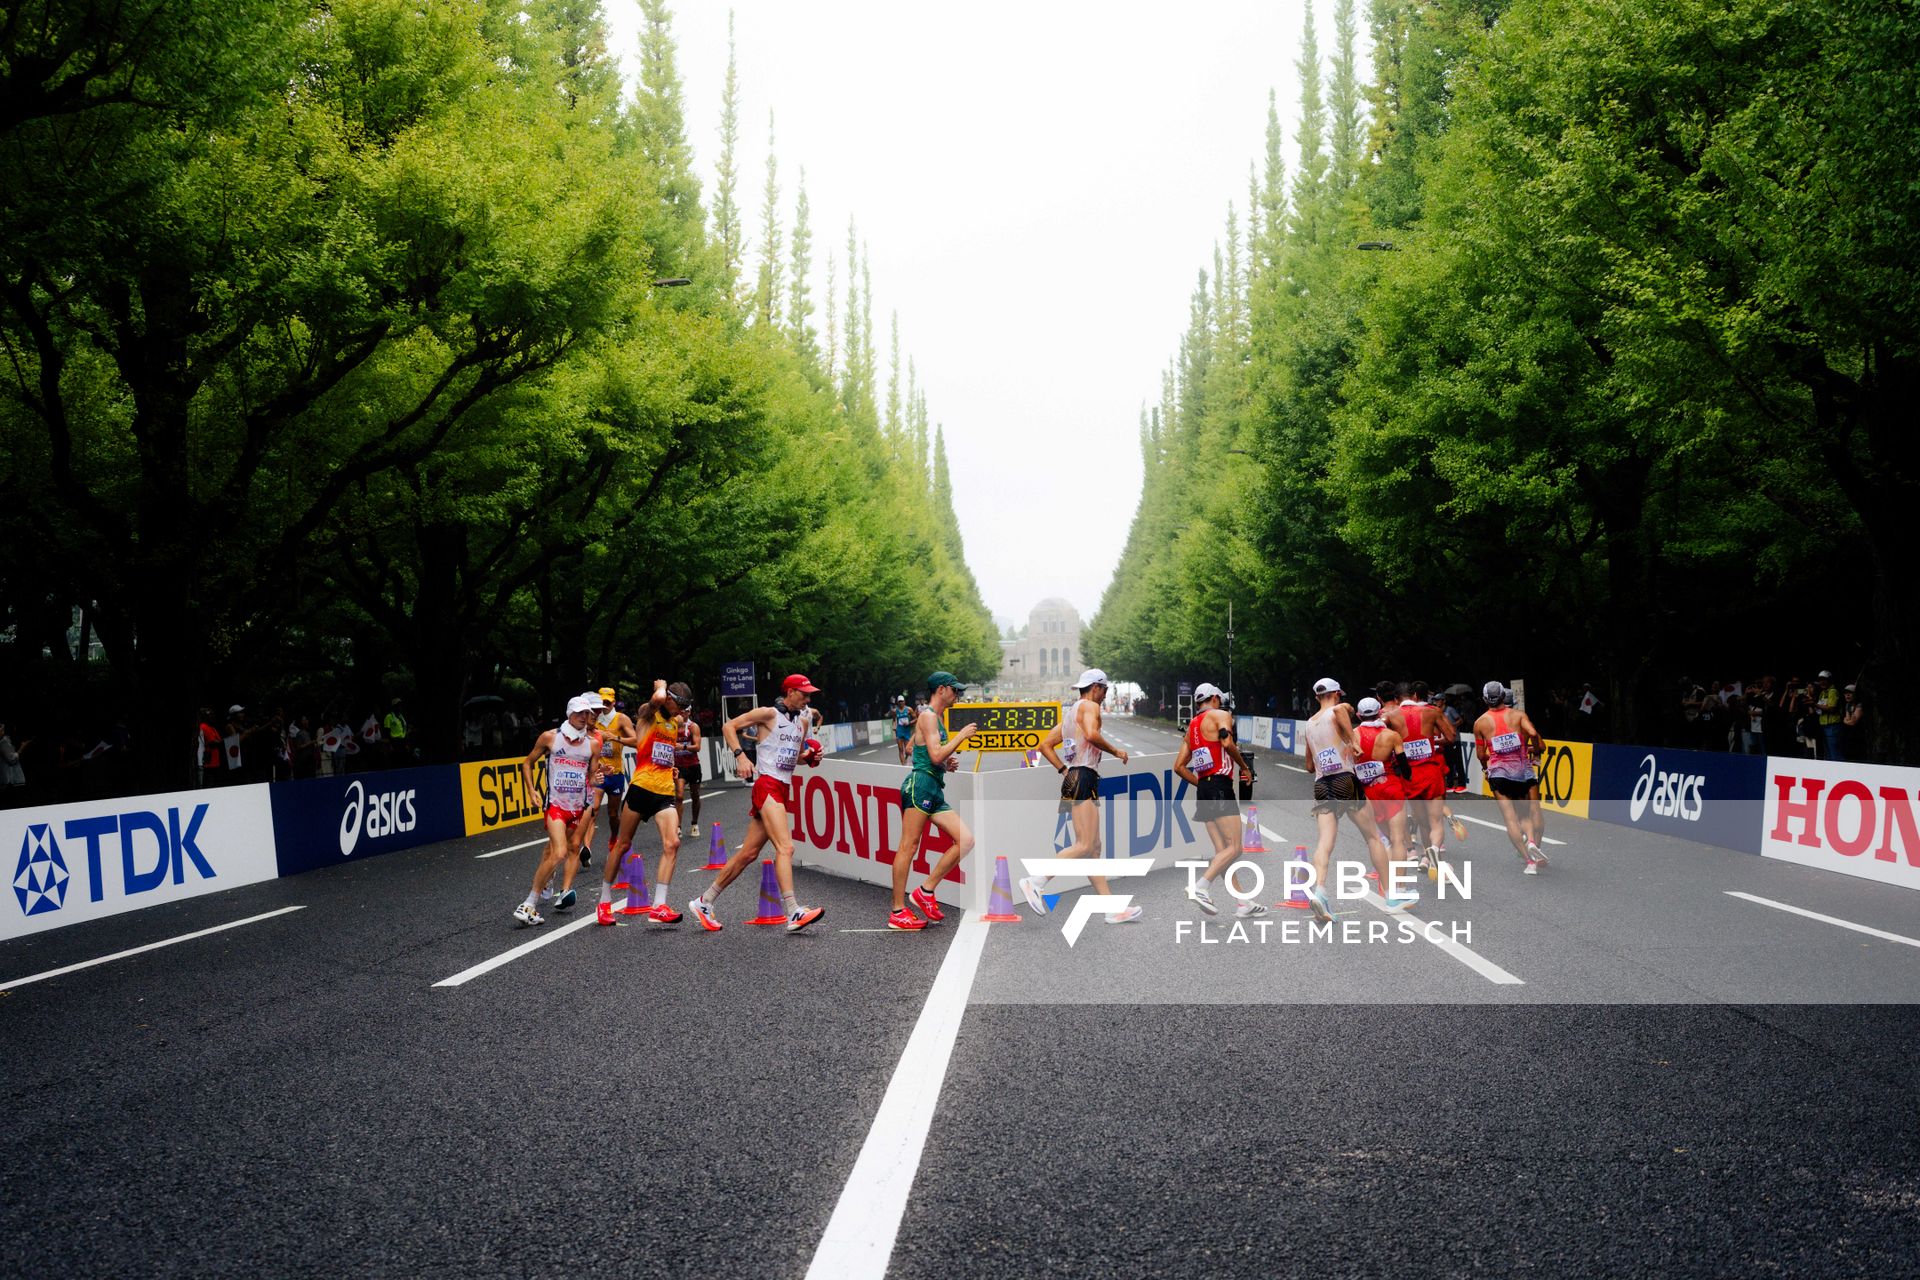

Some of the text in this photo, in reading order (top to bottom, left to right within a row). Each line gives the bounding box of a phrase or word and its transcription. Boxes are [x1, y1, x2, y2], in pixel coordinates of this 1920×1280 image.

[726, 667, 749, 675] Ginkgo
[730, 683, 745, 691] Split
[968, 733, 1040, 749] SEIKO
[1498, 733, 1517, 741] TDK
[1409, 740, 1428, 748] TDK
[554, 757, 587, 768] FRANCE
[1364, 762, 1381, 770] TDK
[564, 771, 583, 779] TDK
[1363, 769, 1378, 778] 314
[1099, 767, 1197, 859] TDK
[787, 775, 966, 885] HONDA
[64, 803, 217, 903] TDK
